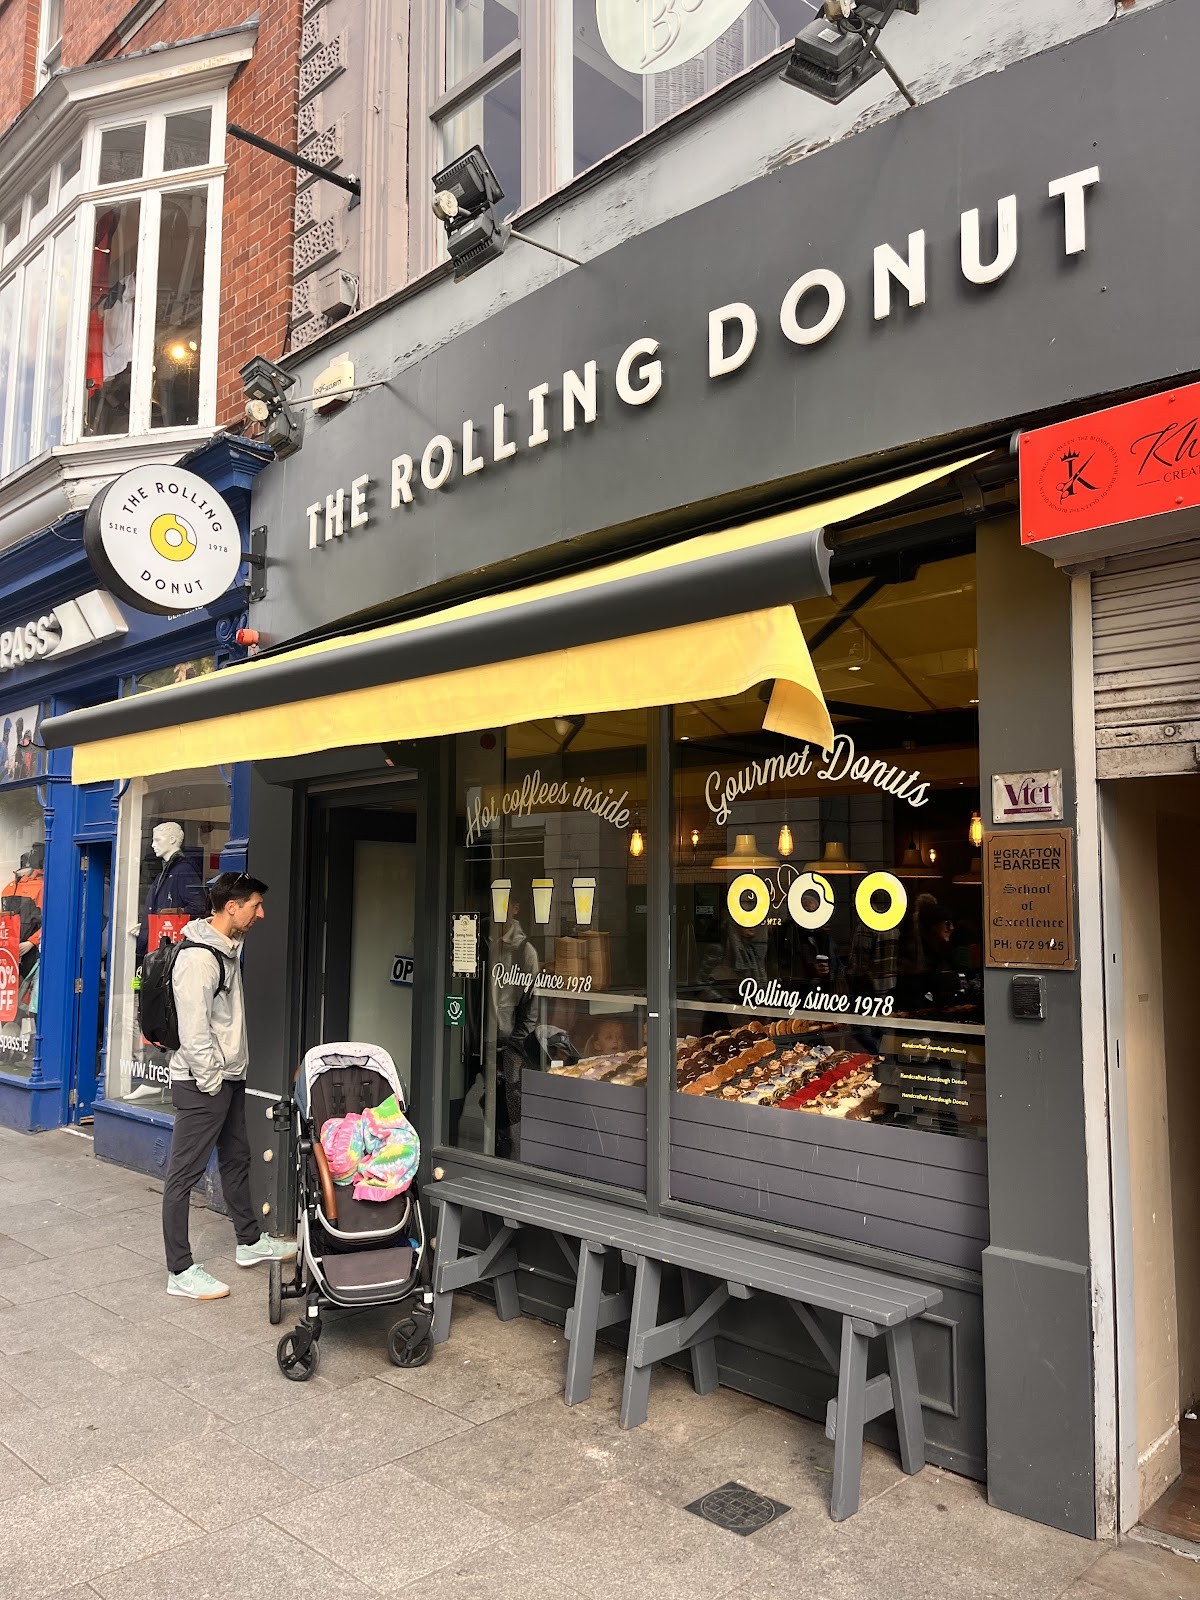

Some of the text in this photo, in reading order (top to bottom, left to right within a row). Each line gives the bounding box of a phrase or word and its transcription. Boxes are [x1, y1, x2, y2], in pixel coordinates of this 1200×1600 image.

[306, 166, 1100, 550] THE ROLLING DONUT
[122, 482, 222, 532] THE ROLLING
[109, 522, 138, 535] SINCE
[208, 544, 228, 553] 1978
[140, 570, 204, 594] DONUT
[704, 734, 931, 825] Gourmet Donuts
[466, 769, 630, 848] Hot coffees inside
[1003, 848, 1060, 858] GRAFTON
[1003, 859, 1060, 870] BARBER
[1003, 884, 1050, 894] School
[1021, 900, 1034, 910] of
[993, 916, 1064, 928] Excellence
[994, 940, 1012, 949] PH:
[1016, 940, 1034, 950] 672
[393, 959, 413, 980] OP
[492, 962, 592, 993] Rolling since 1978
[738, 977, 894, 1018] Rolling since 1978
[927, 1045, 950, 1053] Sourdough
[900, 1072, 926, 1080] Handcrafted
[927, 1076, 950, 1084] Sourdough
[902, 1092, 928, 1100] Handcrafted
[928, 1096, 952, 1104] Sourdough
